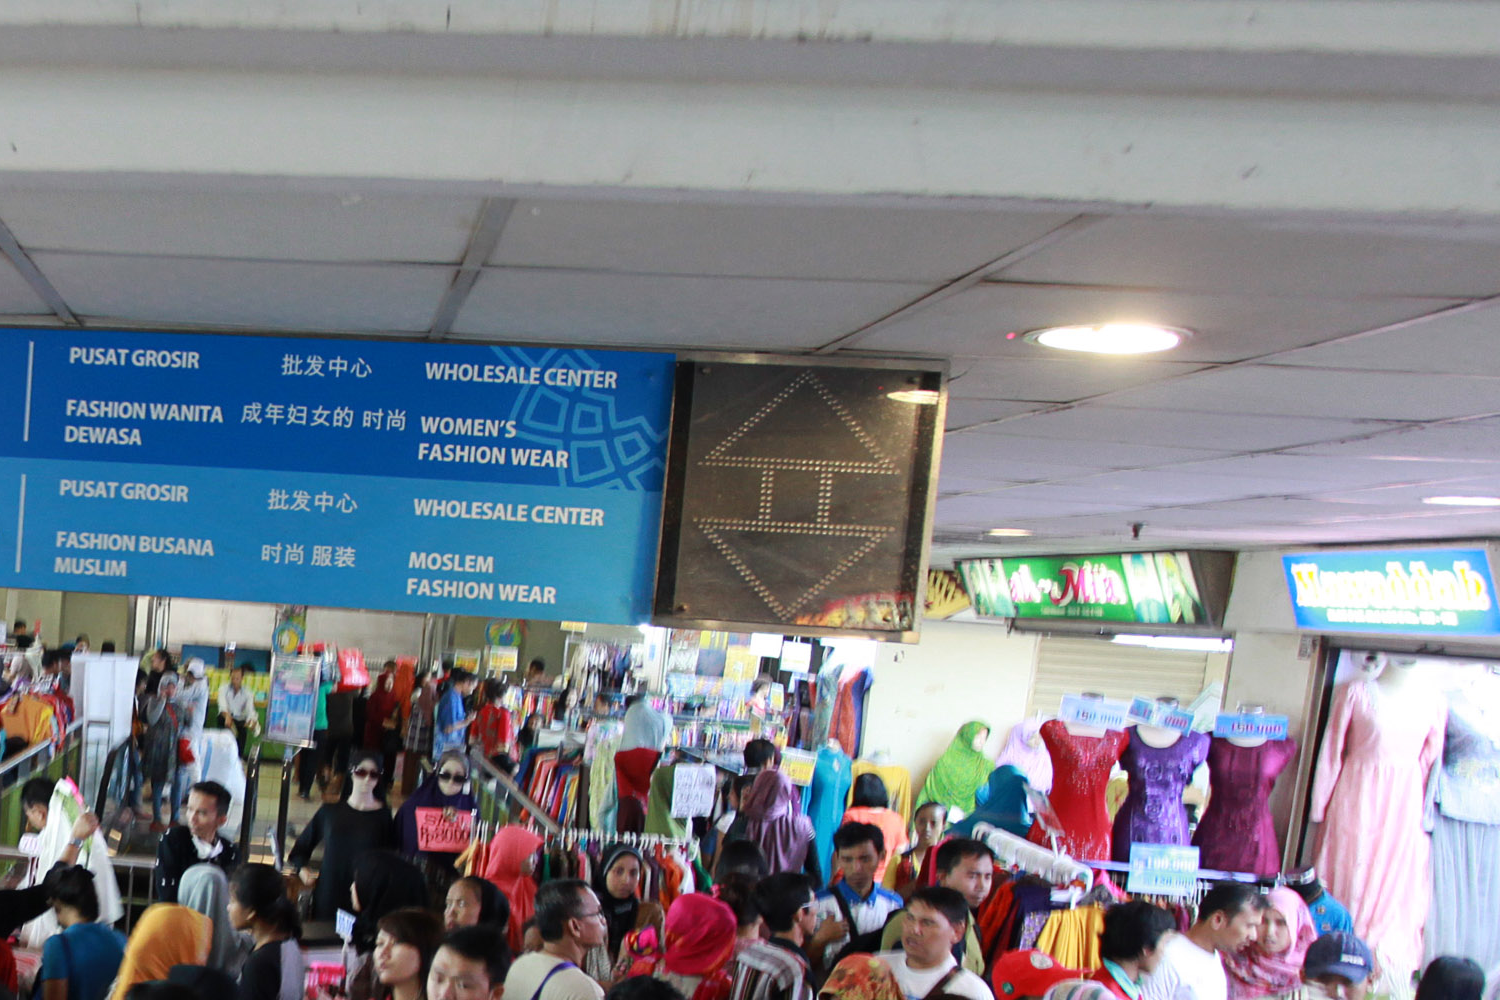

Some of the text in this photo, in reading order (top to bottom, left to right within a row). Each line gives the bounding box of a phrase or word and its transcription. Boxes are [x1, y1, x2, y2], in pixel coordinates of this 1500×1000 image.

[70, 347, 199, 368] PUSAT GROSIR
[283, 355, 372, 377] 批发中心
[426, 363, 617, 388] WHOLESALE CENTER
[67, 400, 223, 422] FASHION WANITA
[242, 403, 405, 430] 成年妇女的 时尚
[65, 426, 141, 445] DEWASA
[421, 416, 516, 438] WOMEN'S
[418, 443, 568, 468] FASHION WEAR
[60, 480, 188, 502] PUSAT GROSIR
[268, 489, 357, 513] 批发中心
[414, 499, 605, 526] WHOLESALE CENTER
[56, 531, 214, 556] FASHION BUSANA
[262, 543, 356, 567] 时尚 服装
[54, 557, 127, 576] MUSLIM
[409, 552, 494, 573] MOSLEM
[407, 578, 557, 604] FASHION WEAR
